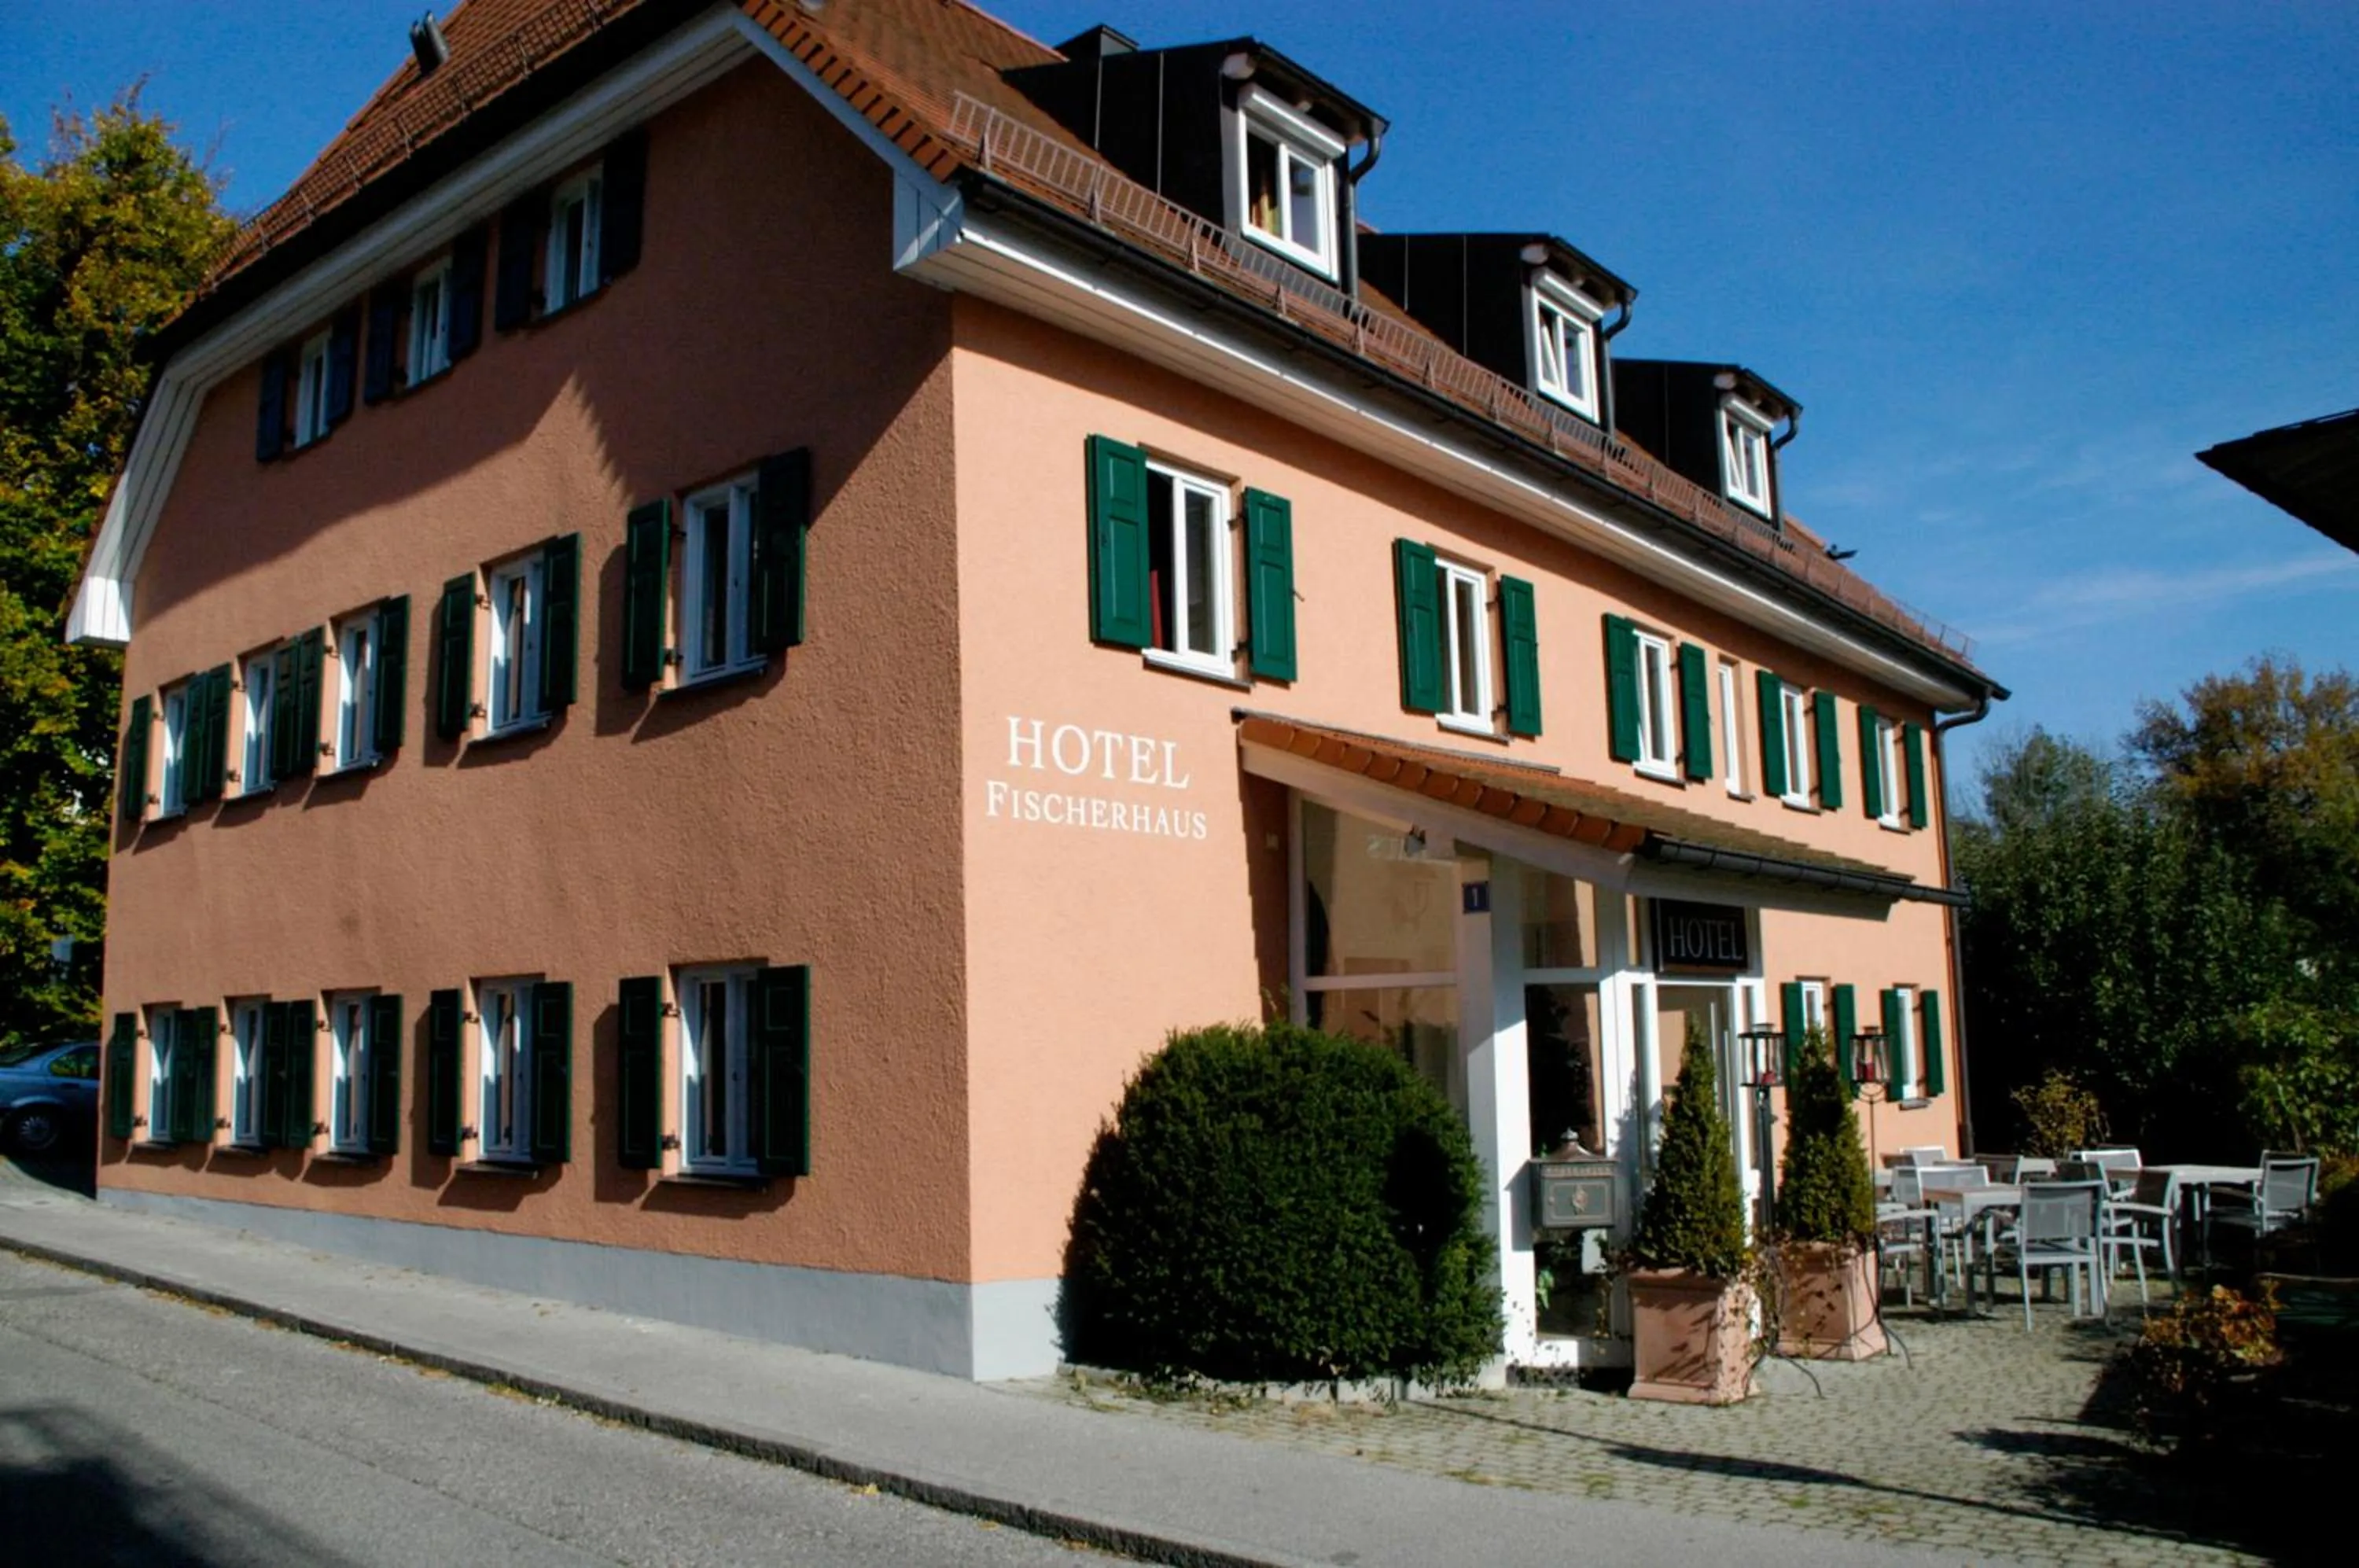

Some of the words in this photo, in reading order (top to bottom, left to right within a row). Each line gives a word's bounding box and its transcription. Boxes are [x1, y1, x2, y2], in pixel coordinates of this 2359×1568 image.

[1007, 715, 1190, 790] HOTEL
[986, 778, 1207, 840] FISCHERHAUS
[1668, 915, 1744, 961] HOTEL
